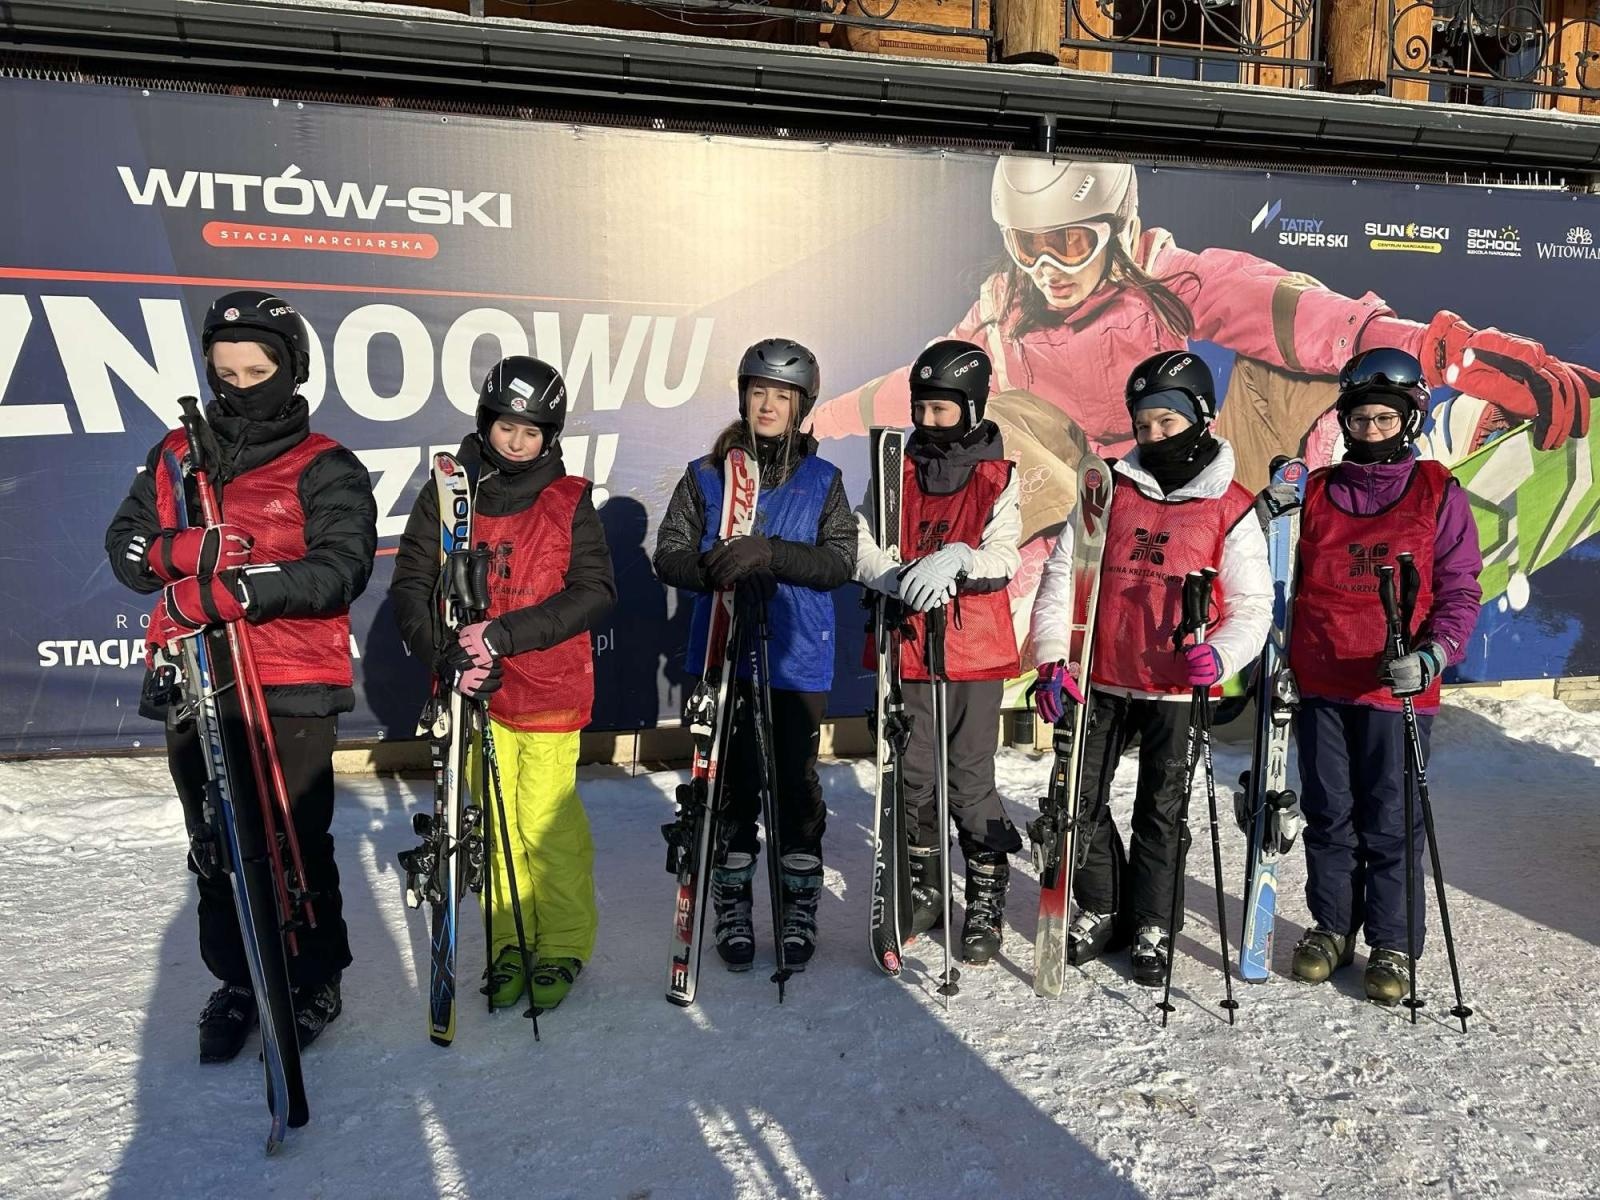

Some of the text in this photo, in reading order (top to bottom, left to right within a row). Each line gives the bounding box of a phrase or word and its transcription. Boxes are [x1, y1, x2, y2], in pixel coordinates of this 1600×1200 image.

[116, 163, 513, 229] WITÓW-SKI
[1279, 217, 1324, 233] TATRY
[1364, 222, 1450, 240] SUN SKI
[1467, 228, 1498, 239] SUN
[219, 229, 425, 251] STACJA NARCIARSKA
[1278, 231, 1348, 248] SUPER SKI
[1466, 238, 1522, 252] SCHOOL
